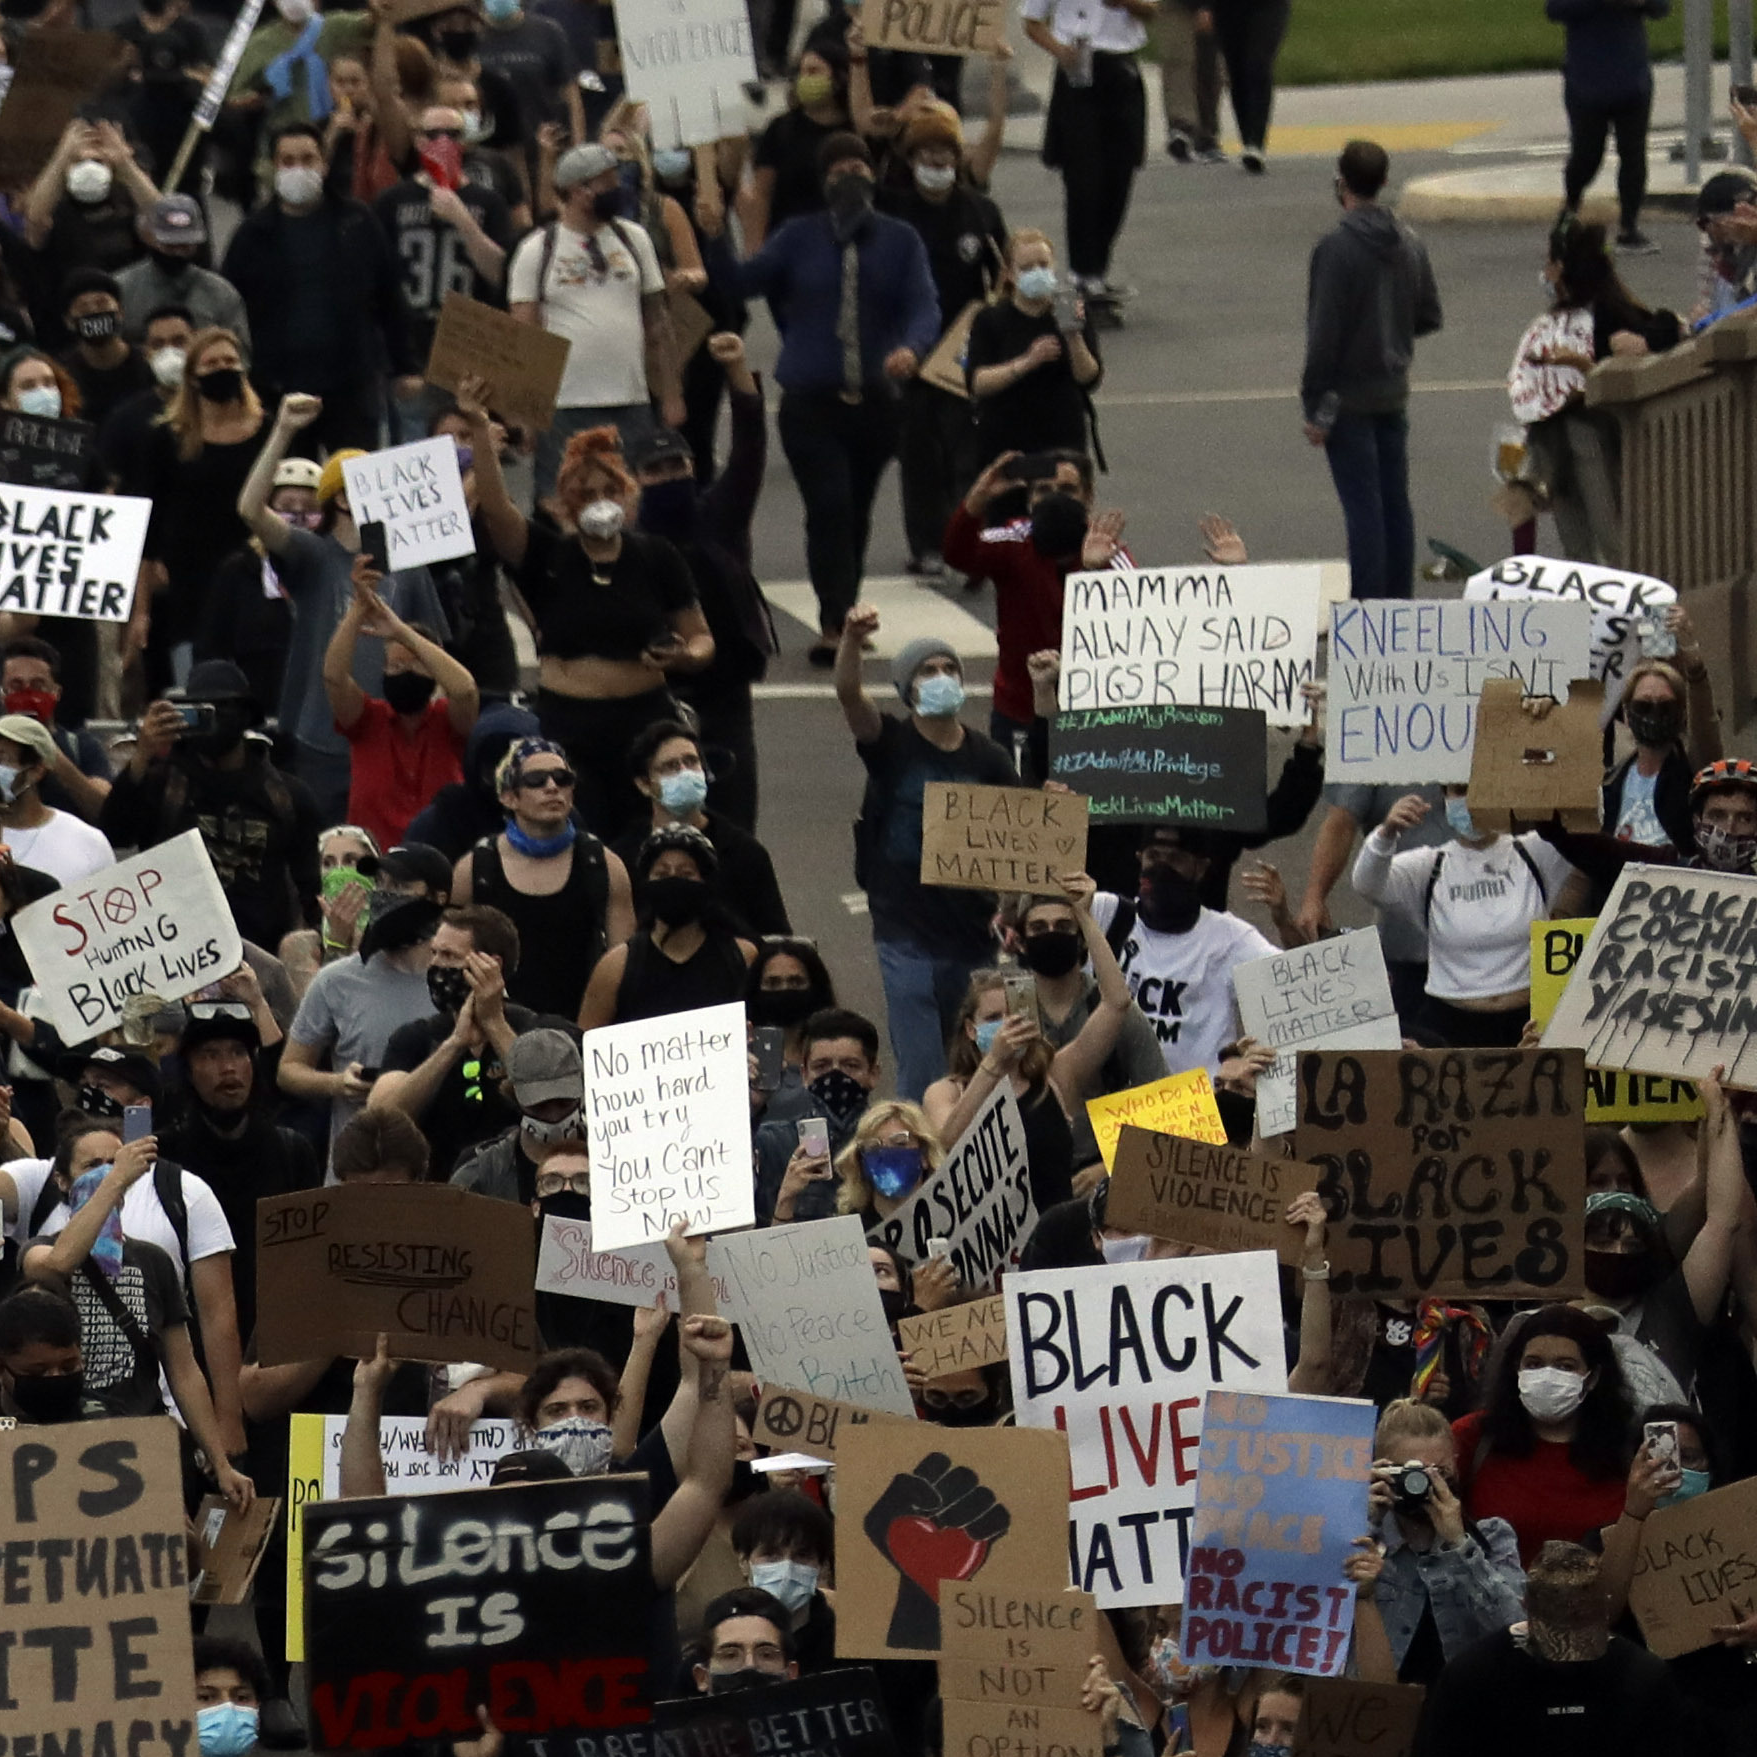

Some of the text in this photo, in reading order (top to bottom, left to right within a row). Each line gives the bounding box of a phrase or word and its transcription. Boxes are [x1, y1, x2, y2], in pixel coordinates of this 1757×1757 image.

[1072, 576, 1235, 612] MAMMA
[1070, 612, 1293, 661] ALWAY SAID
[1334, 604, 1549, 658] KNEELING
[1067, 658, 1315, 711] PIGS R HARAM
[944, 793, 1062, 831] BLACK
[965, 827, 1040, 854] LIVES
[934, 854, 1062, 887] MATTER
[51, 867, 164, 960] STOP
[158, 938, 223, 984] LIVES
[1299, 1049, 1569, 1132] LA RAZA
[1313, 1149, 1555, 1227] BLACK
[1017, 1286, 1260, 1401] BLACK
[425, 1592, 525, 1647] IS
[1007, 1635, 1032, 1659] IS
[311, 1658, 655, 1749] VIOLENCE
[977, 1666, 1058, 1697] NOT
[1006, 1707, 1041, 1733] AN
